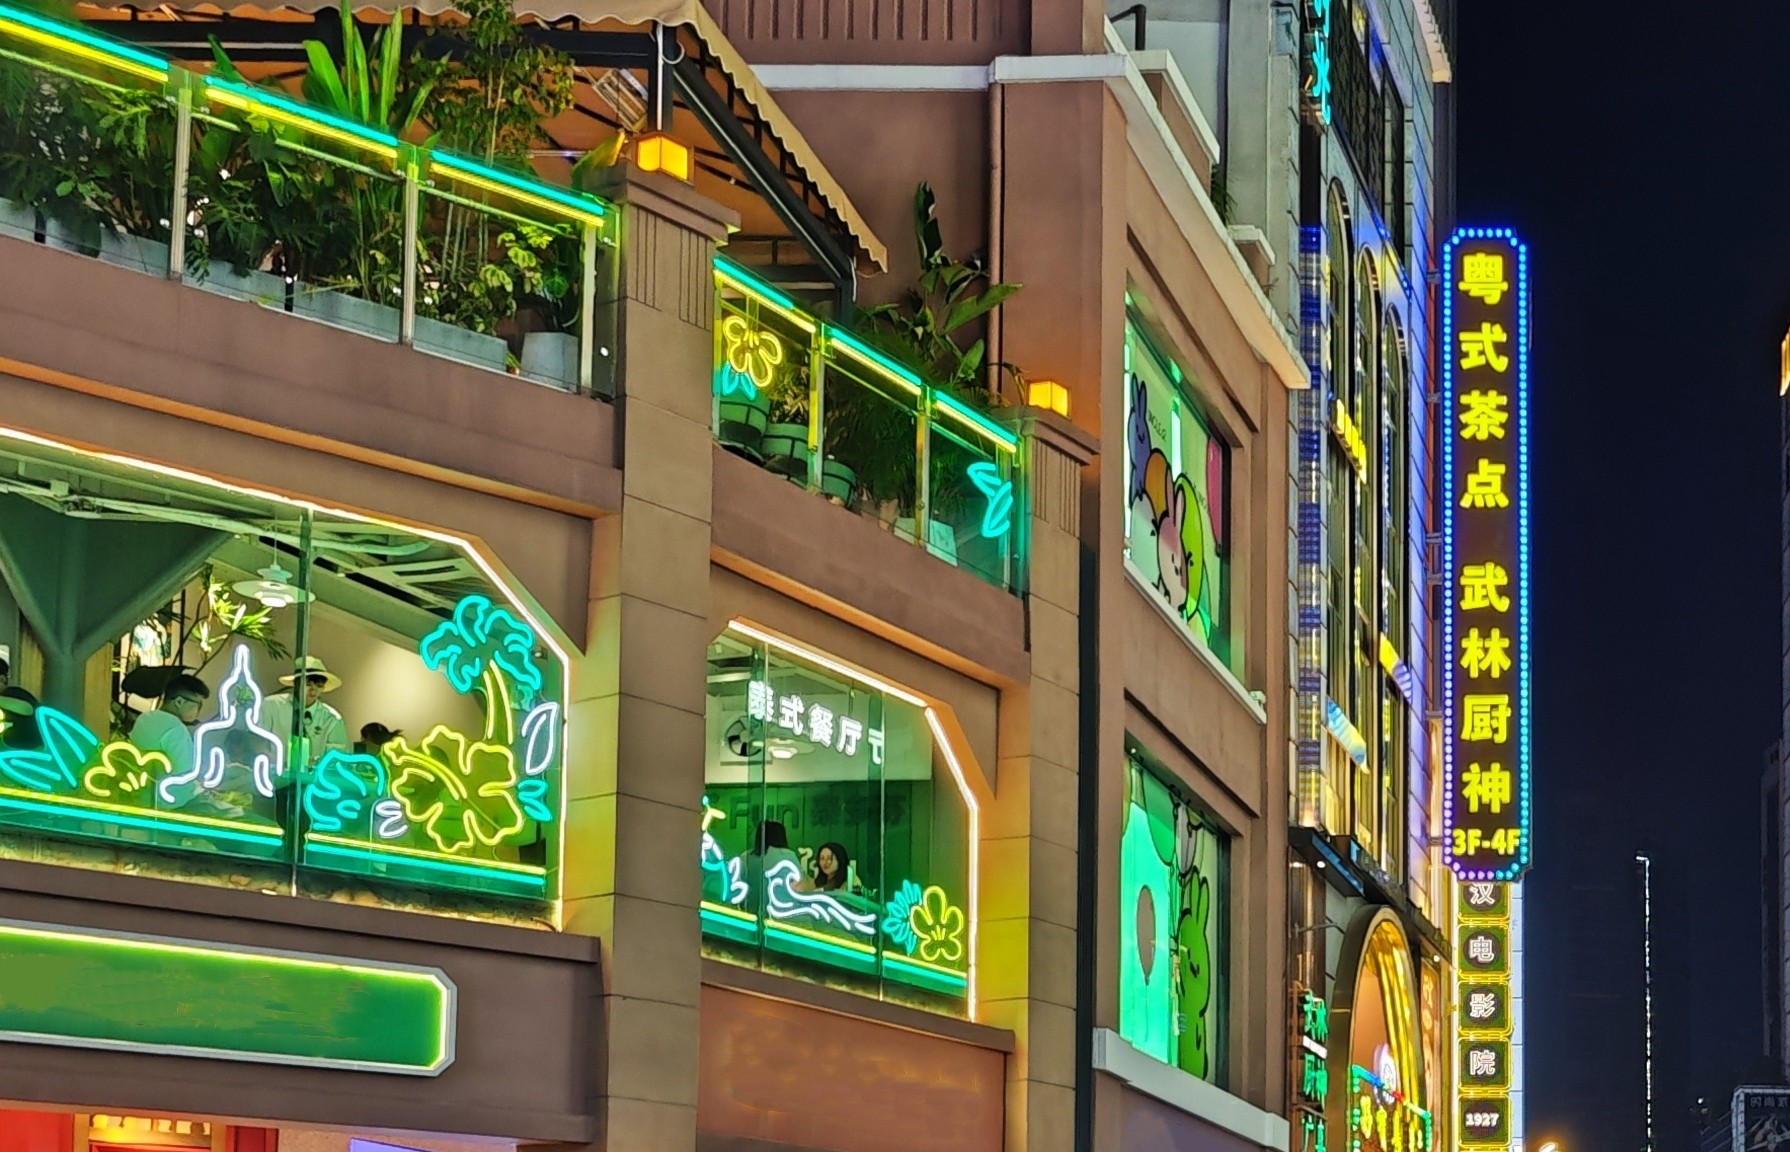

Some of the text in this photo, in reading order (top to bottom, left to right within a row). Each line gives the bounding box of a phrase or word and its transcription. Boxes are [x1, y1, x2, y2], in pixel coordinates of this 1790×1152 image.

[1451, 252, 1521, 857] 粤式茶点 武林厨神 3F-4F
[1466, 1112, 1499, 1128] 1927
